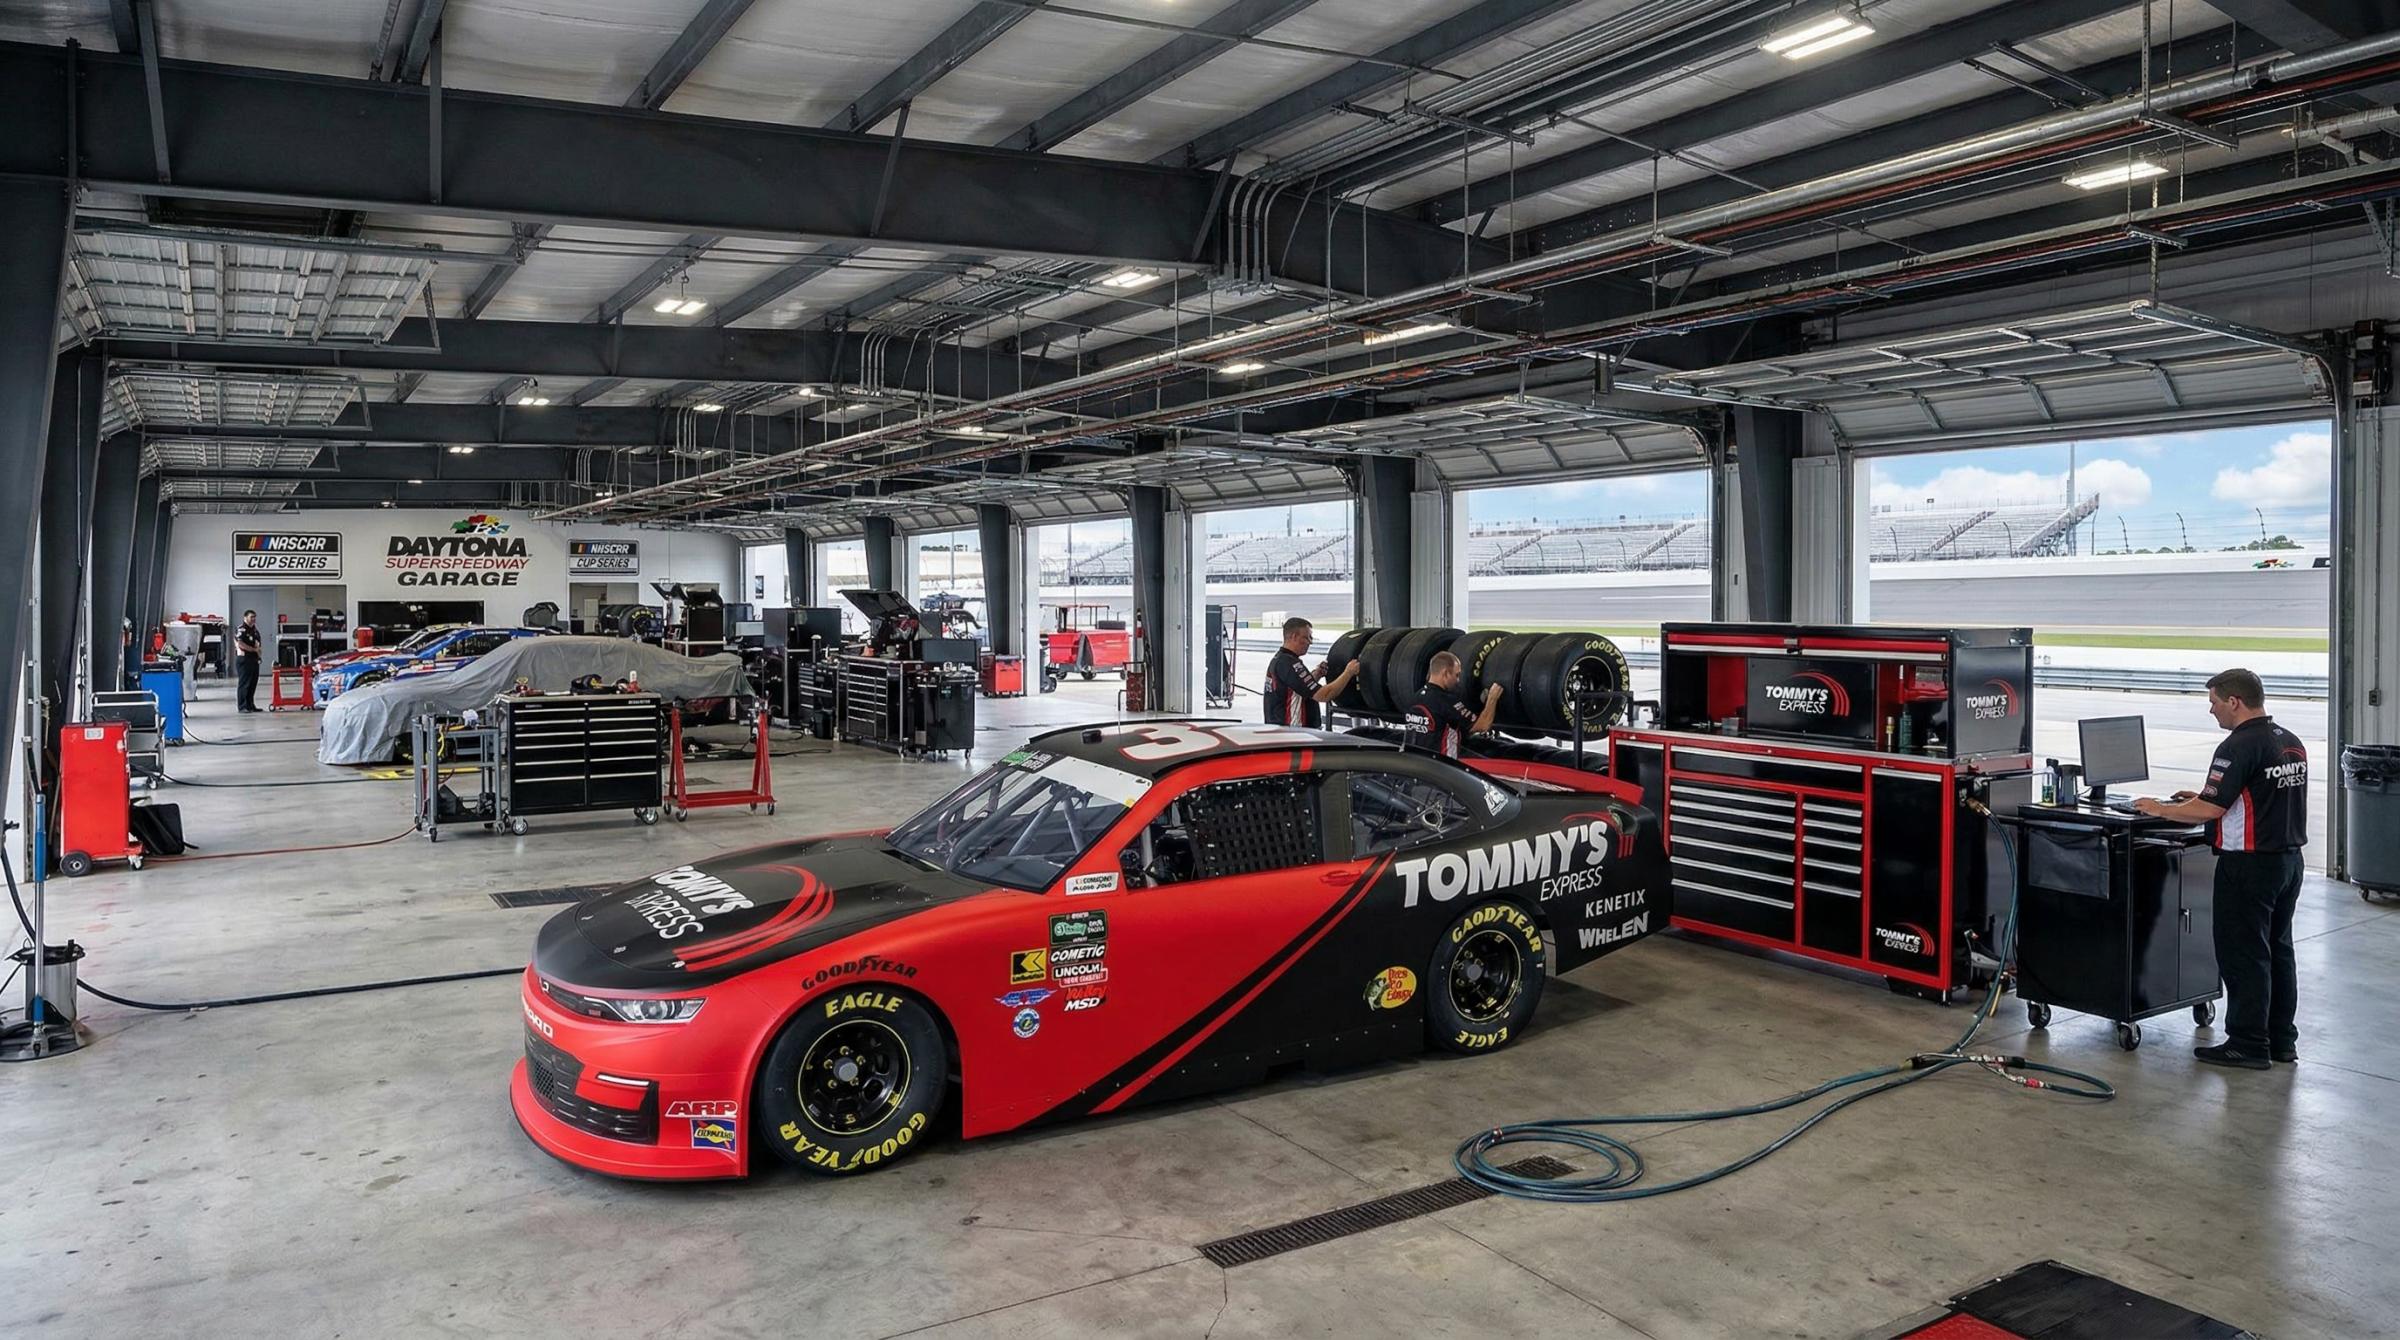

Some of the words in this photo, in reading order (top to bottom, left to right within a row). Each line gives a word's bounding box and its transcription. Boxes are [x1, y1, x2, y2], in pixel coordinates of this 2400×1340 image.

[268, 536, 326, 550] NASCAR
[387, 536, 527, 557] DAYTONA
[248, 556, 277, 569] CUP
[278, 556, 327, 569] SERIES
[385, 557, 530, 569] SUPERSPEEDWAY
[577, 558, 596, 568] CUP
[597, 558, 629, 568] SERIES
[397, 571, 519, 586] GARAGE
[1765, 685, 1829, 702] TOMMY'S
[1779, 699, 1826, 714] EXPRESS
[1394, 820, 1609, 909] TOMMY'S
[1540, 865, 1604, 902] EXPRESS
[1585, 888, 1646, 919] KENETIX
[1578, 910, 1650, 950] WHELEN
[1051, 943, 1105, 962] COMETIC
[801, 955, 918, 991] GOODYEAR
[825, 991, 904, 1019] EAGLE
[1064, 997, 1101, 1012] MSD
[1456, 1027, 1508, 1048] EAGLE
[664, 1100, 738, 1119] ARP
